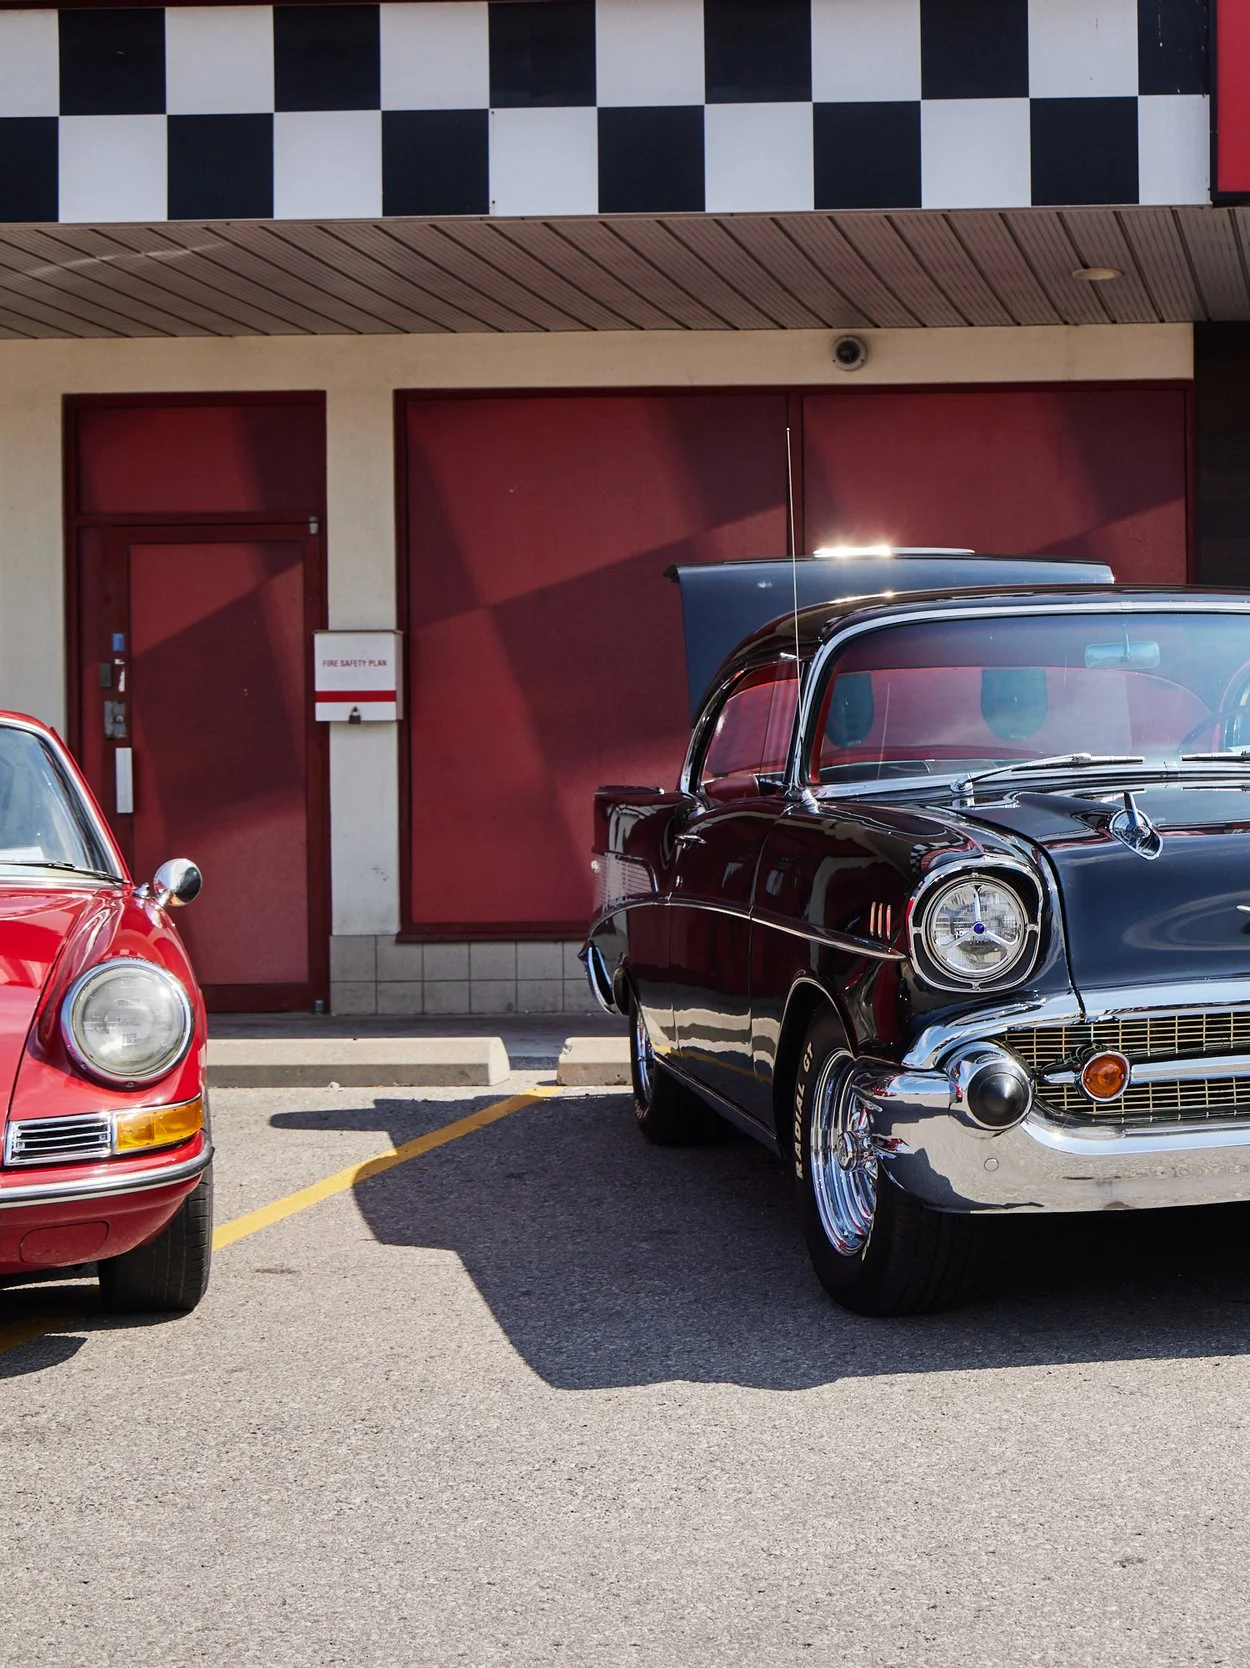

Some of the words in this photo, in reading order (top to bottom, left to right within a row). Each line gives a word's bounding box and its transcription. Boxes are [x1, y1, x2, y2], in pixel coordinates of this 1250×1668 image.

[323, 660, 338, 668] FIRE
[341, 660, 366, 668] SAFETY
[368, 659, 388, 668] PLAN
[795, 1083, 805, 1180] RADIAL
[803, 1041, 813, 1072] GT
